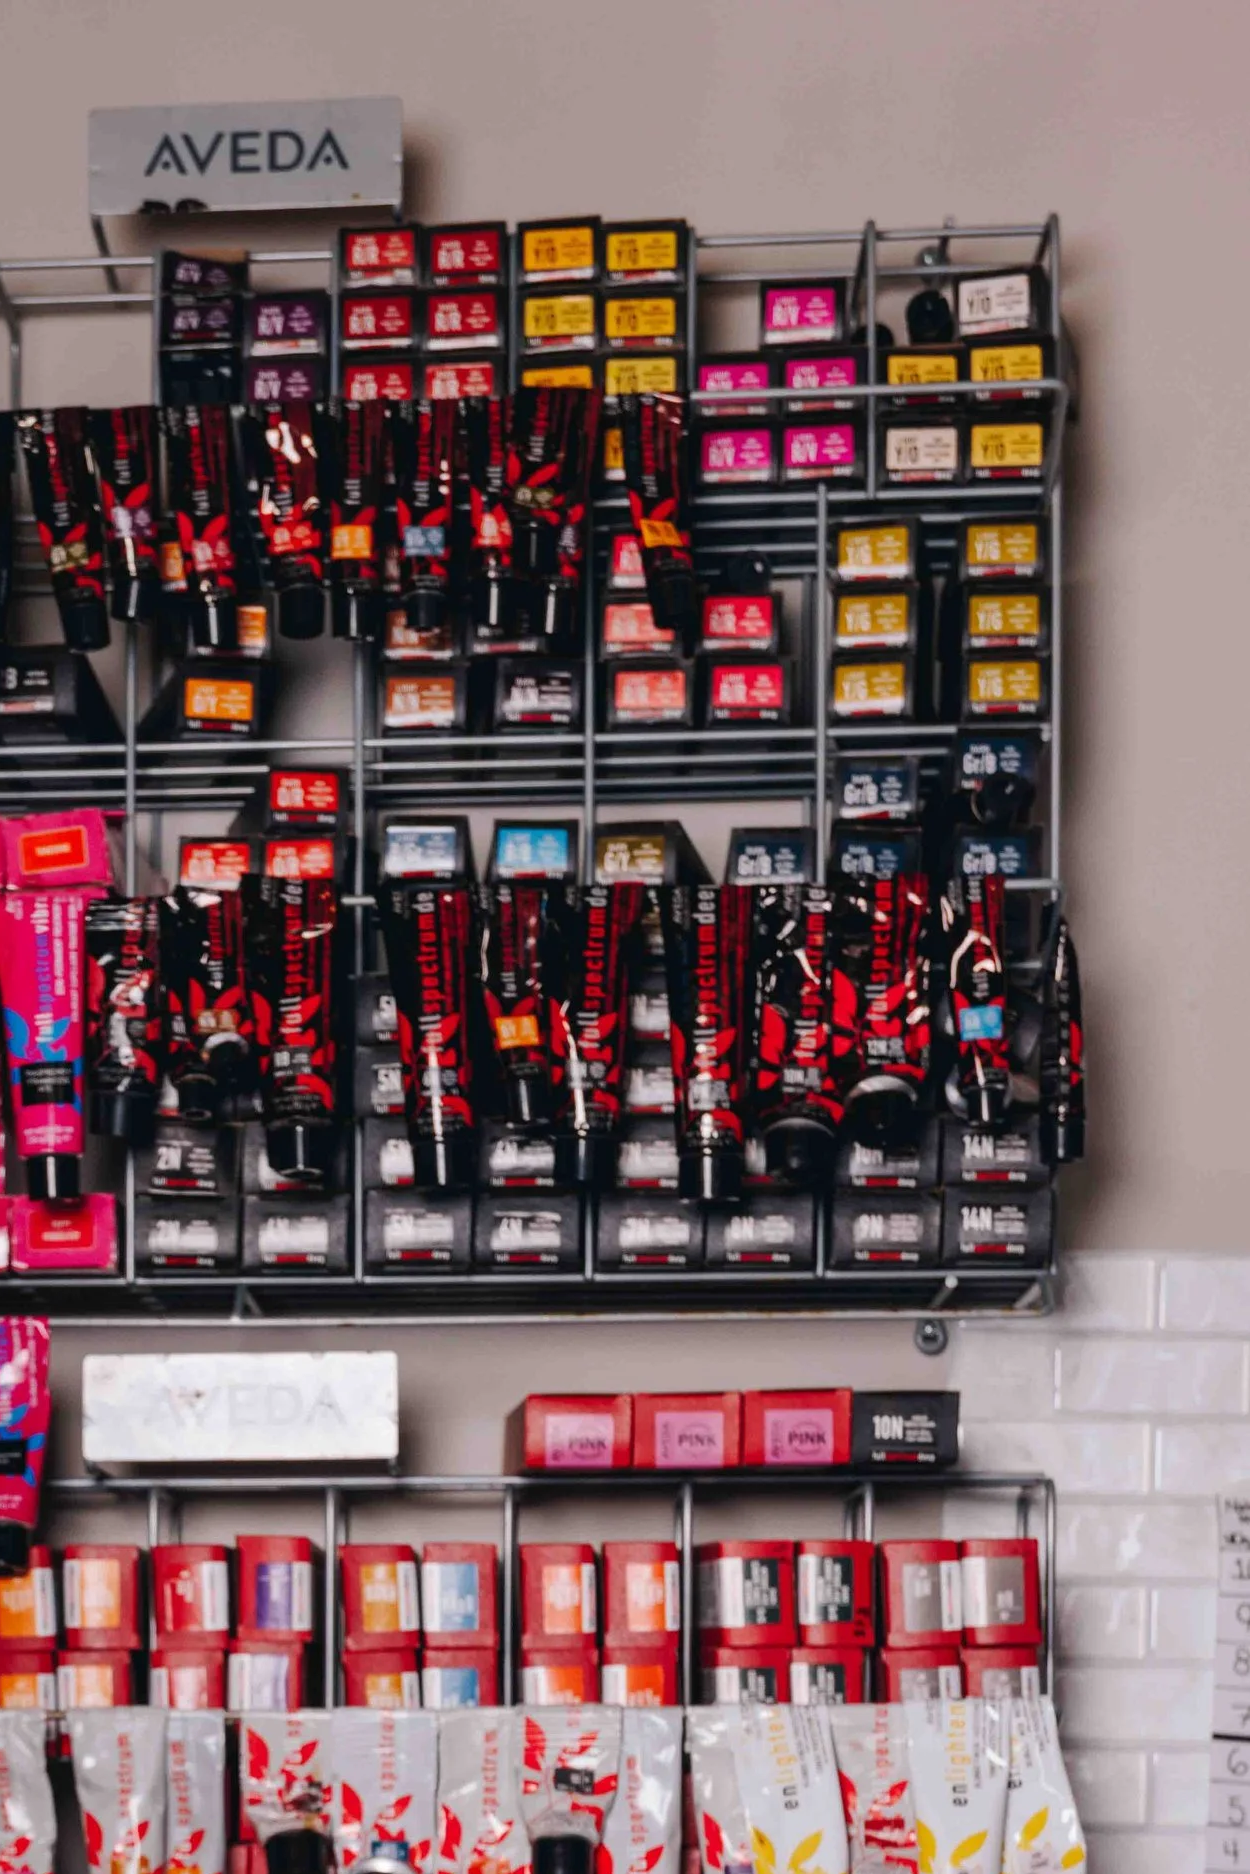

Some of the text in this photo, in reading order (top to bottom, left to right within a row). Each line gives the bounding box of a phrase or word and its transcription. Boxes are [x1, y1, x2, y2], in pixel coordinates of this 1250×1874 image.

[144, 128, 350, 177] AVEDA
[678, 1432, 717, 1447] PINK
[788, 1431, 826, 1447] PINK
[873, 1415, 903, 1440] 10N
[568, 1436, 607, 1451] PINK
[1233, 1645, 1250, 1676] 8
[1227, 1746, 1250, 1777] 6
[1228, 1795, 1246, 1827] 5
[1223, 1838, 1240, 1865] 4
